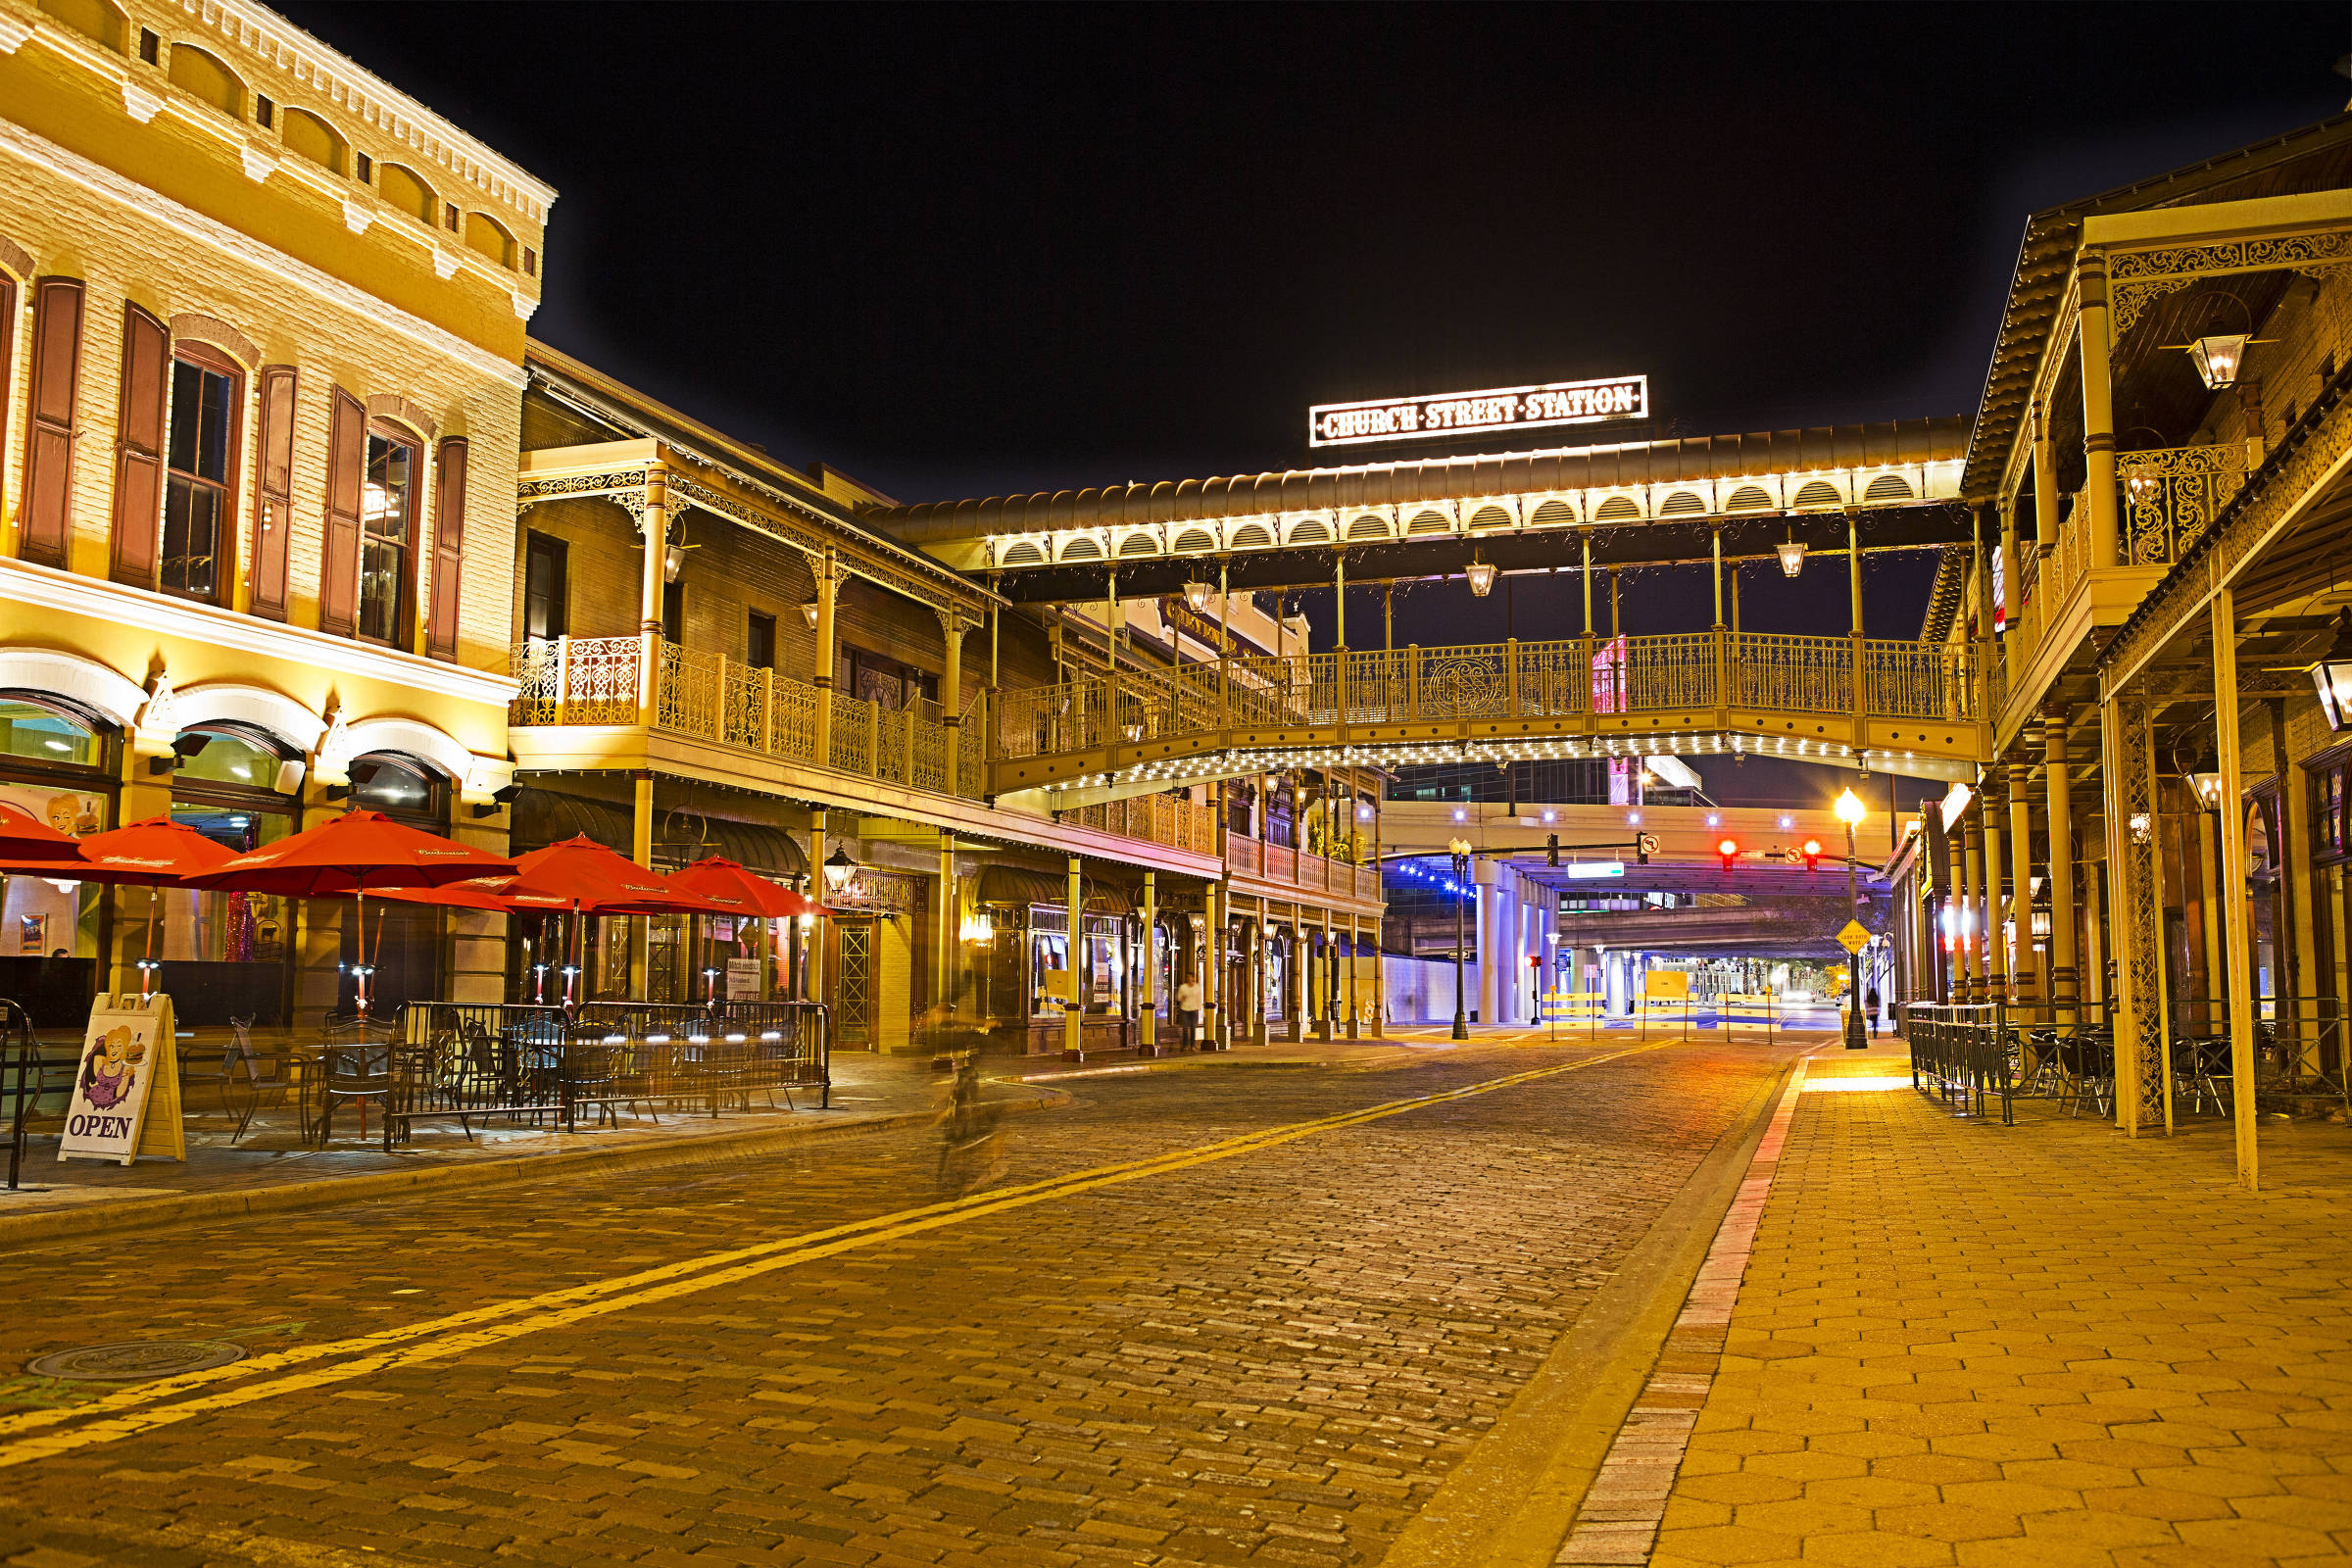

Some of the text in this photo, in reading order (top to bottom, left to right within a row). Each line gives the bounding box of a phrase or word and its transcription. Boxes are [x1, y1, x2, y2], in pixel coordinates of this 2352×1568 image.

[1323, 385, 1634, 438] CHURCH STREET STATION
[70, 1114, 133, 1140] OPEN
